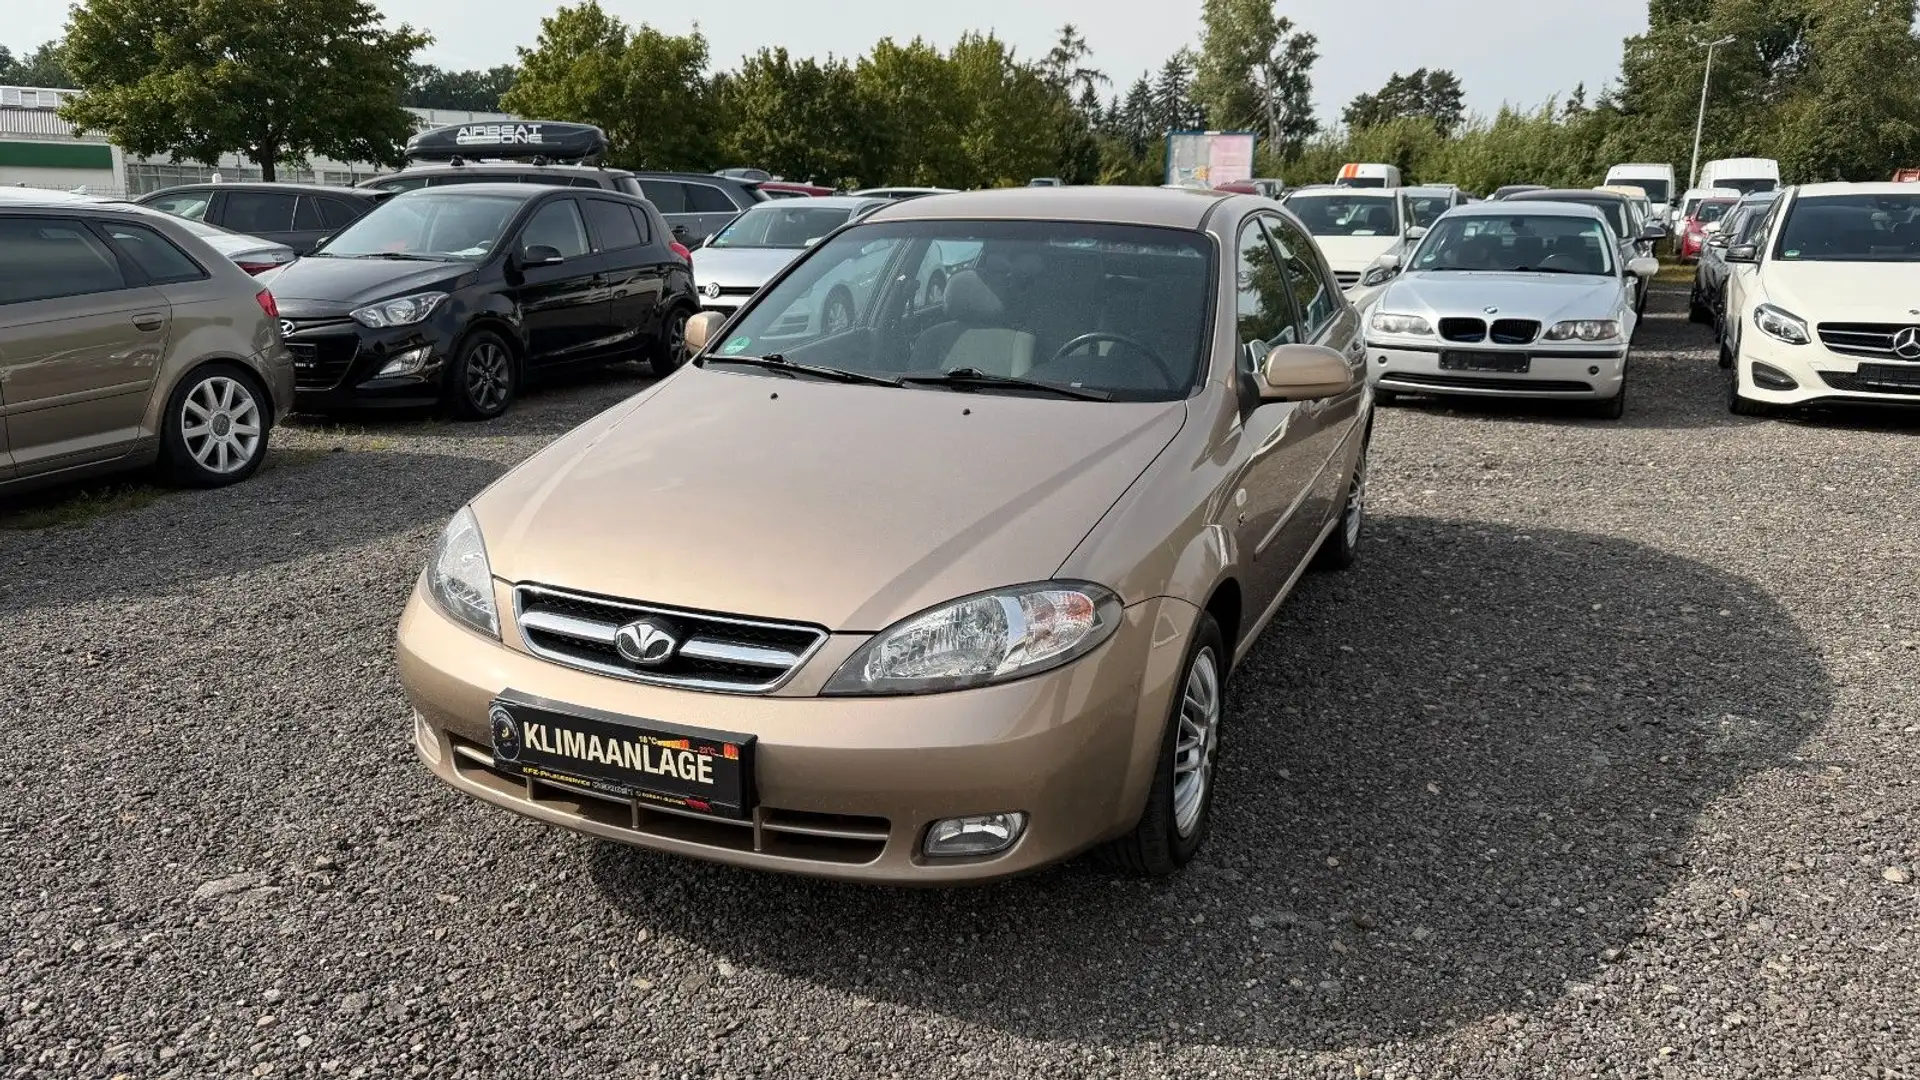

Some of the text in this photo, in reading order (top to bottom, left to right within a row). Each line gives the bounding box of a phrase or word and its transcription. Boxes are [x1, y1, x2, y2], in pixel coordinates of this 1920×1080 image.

[457, 124, 542, 136] AIRBEAT
[501, 133, 543, 144] ONE
[523, 721, 714, 784] KLIMAANLAGE
